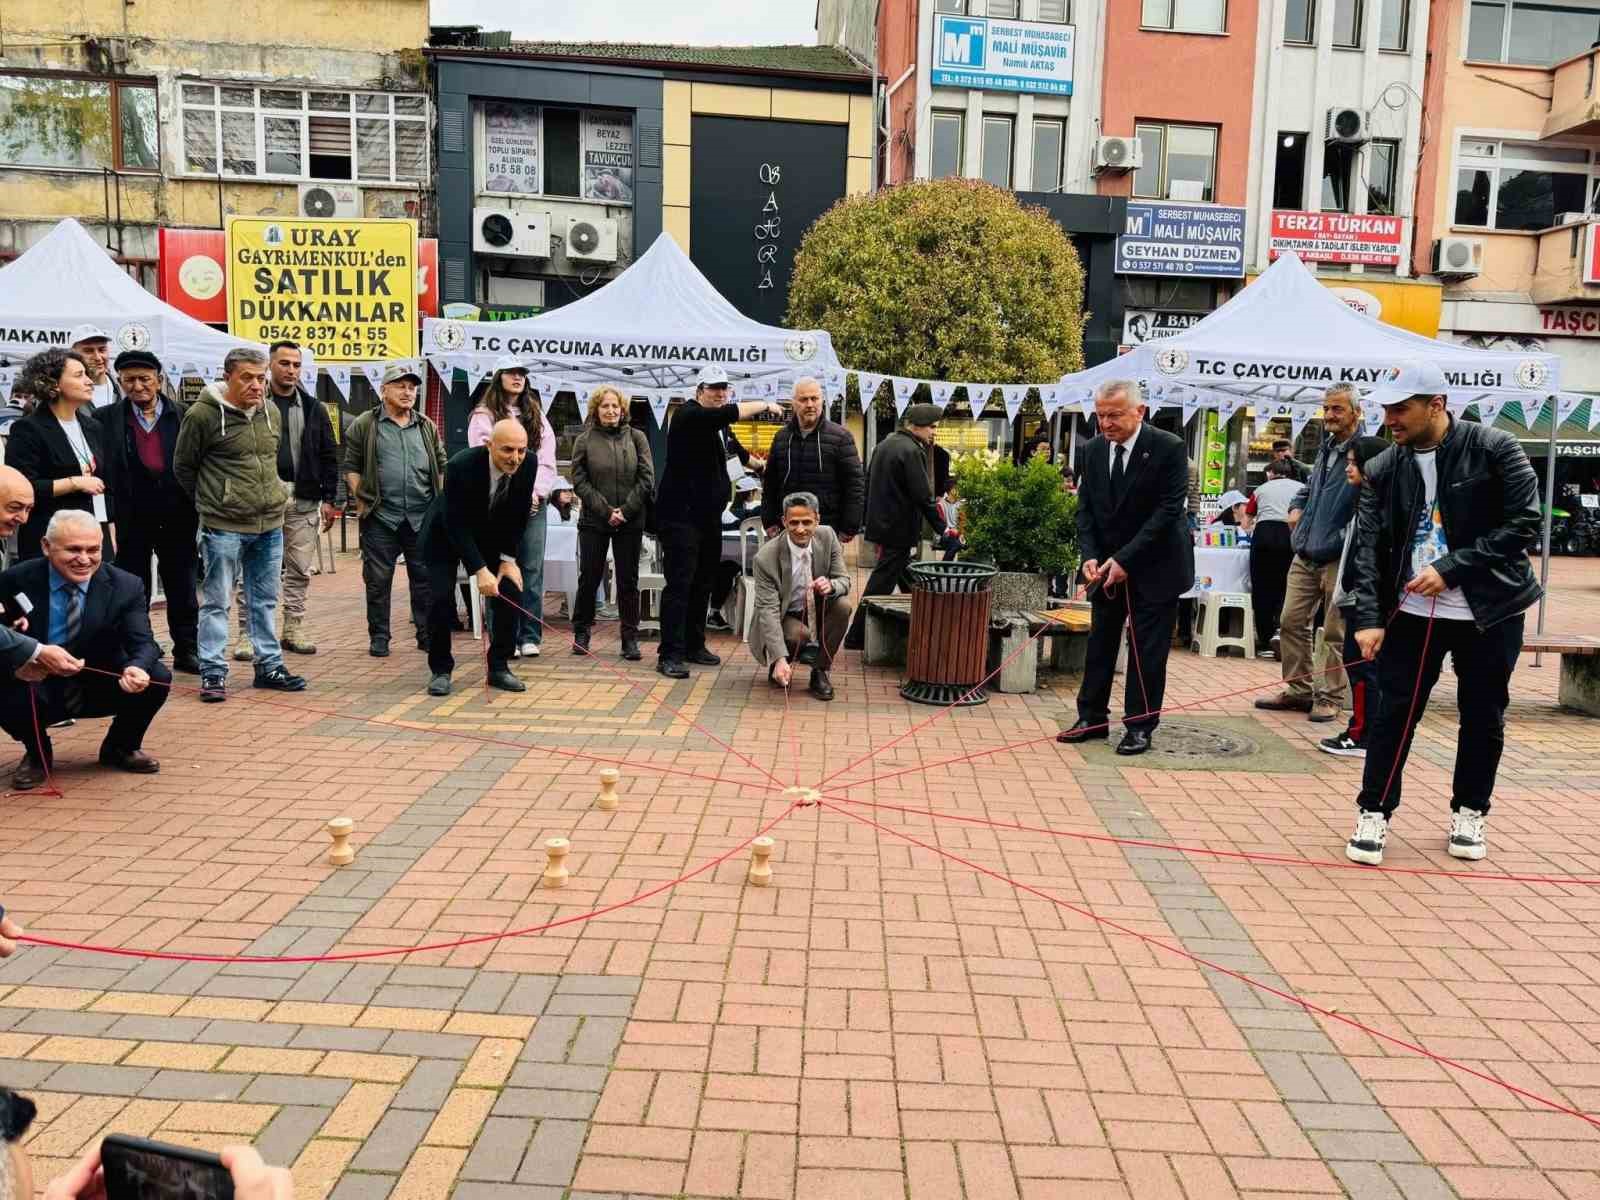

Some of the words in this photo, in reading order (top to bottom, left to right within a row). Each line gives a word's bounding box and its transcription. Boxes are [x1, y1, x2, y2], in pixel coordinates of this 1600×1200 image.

[991, 27, 1022, 37] SERBEST
[993, 39, 1018, 54] MALİ
[1021, 41, 1067, 59] MÜŞAVİR
[597, 129, 620, 139] BEYAZ
[488, 146, 508, 154] TOPLU
[489, 163, 506, 174] 615
[510, 165, 521, 174] 58
[1158, 209, 1192, 220] SERBEST
[1154, 222, 1184, 239] MALİ
[1187, 224, 1242, 243] MÜŞAVİR
[1328, 215, 1396, 235] TÜRKAN
[291, 229, 361, 247] URAY
[1126, 245, 1179, 258] SEYHAN
[1183, 246, 1237, 260] DÜZMEN
[254, 267, 392, 296] SATILIK
[240, 296, 405, 323] DÜKKANLAR
[259, 326, 301, 340] 0542
[306, 326, 336, 340] 837
[342, 327, 361, 340] 41
[367, 328, 388, 340] 55
[343, 344, 361, 356] 05
[367, 344, 388, 357] 72
[472, 336, 500, 351] T.C
[507, 338, 604, 356] ÇAYCUMA
[610, 342, 767, 362] KAYMAKAMLIĞI
[1196, 360, 1226, 375] T.C
[1233, 362, 1333, 381] ÇAYCUMA
[1556, 446, 1600, 456] TAŞCI
